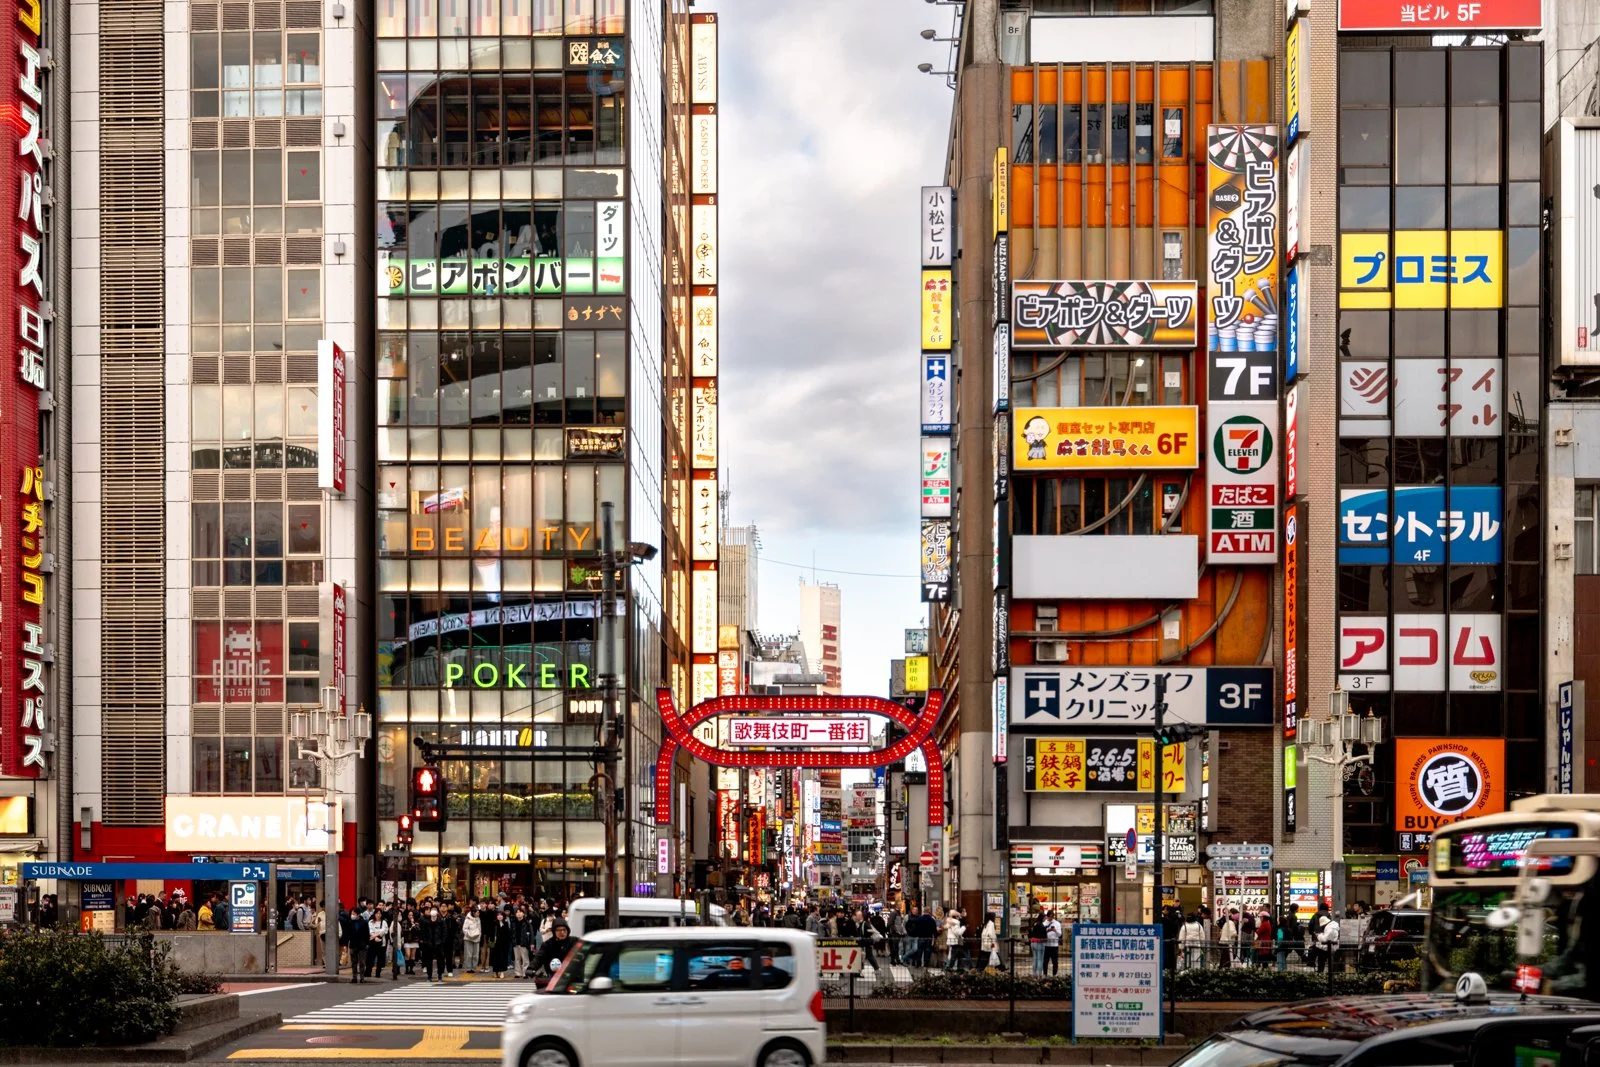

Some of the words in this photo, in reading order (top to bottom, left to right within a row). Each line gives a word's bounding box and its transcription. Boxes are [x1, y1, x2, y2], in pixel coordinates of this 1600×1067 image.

[705, 15, 714, 23] 10
[1400, 5, 1450, 21] 当ビル
[1457, 4, 1481, 22] 5F
[1008, 26, 1020, 35] 8F
[589, 48, 620, 64] 魚金
[708, 106, 715, 114] 9
[700, 119, 709, 157] CASINO
[700, 159, 709, 190] POKER
[928, 192, 945, 261] 小松ビル
[1244, 161, 1276, 274] ビアポン
[602, 204, 619, 250] ダーツ
[410, 260, 591, 292] ビアポンバー
[1353, 251, 1493, 285] プロミス
[708, 288, 715, 296] 7
[1016, 294, 1193, 329] ビアポン&ダーツ
[708, 380, 715, 388] 6
[1215, 357, 1273, 396] 7F
[1437, 367, 1496, 393] アイ
[1056, 438, 1153, 457] 麻雀龍馬くん
[1157, 432, 1189, 455] 6F
[709, 471, 716, 479] 5
[1217, 485, 1269, 505] たばこ
[1230, 509, 1255, 529] 酒
[1341, 510, 1500, 543] セントラル
[20, 464, 44, 606] パチンコ
[411, 527, 591, 551] BEAUTY
[1216, 534, 1272, 553] ATM
[1413, 550, 1431, 562] 4F
[708, 562, 715, 570] 4
[925, 584, 948, 599] 7F
[906, 630, 928, 641] ポケット
[911, 641, 924, 652] ビル
[1342, 626, 1496, 668] アコム
[709, 655, 715, 664] 3
[212, 658, 271, 686] GAME
[445, 662, 591, 689] POKER
[1065, 673, 1194, 693] メンズライフ
[1352, 676, 1375, 689] 3F
[23, 621, 46, 769] エスパス
[212, 688, 236, 697] TATO
[237, 688, 271, 697] STAION
[1219, 682, 1263, 709] 3F
[1065, 700, 1169, 720] クリニック
[734, 722, 865, 741] 歌舞伎町一番街
[1047, 742, 1076, 752] 名物
[1164, 745, 1184, 766] ール
[1427, 743, 1469, 756] PAWNSHOP
[1026, 756, 1035, 773] 2F
[1040, 754, 1082, 771] 鉄鍋
[1410, 754, 1427, 780] BRANDS
[1470, 751, 1491, 779] WATCHES
[1040, 771, 1081, 789] 餃子
[1098, 766, 1126, 782] 酒場
[1426, 760, 1474, 811] 質
[1410, 782, 1424, 810] LUXURY
[1477, 781, 1491, 810] JEWELRY
[172, 814, 283, 840] CRANE
[1404, 815, 1442, 829] BUY
[1169, 837, 1188, 845] BUZZ
[1401, 834, 1411, 850] 買取
[31, 865, 93, 877] SUBNADE
[242, 866, 251, 878] P
[83, 883, 113, 894] SUBNADE
[233, 887, 246, 905] P
[84, 916, 90, 930] 3
[1079, 927, 1156, 936] 道路切替のお知らせ
[1080, 938, 1155, 951] 新宿駅西口駅前広場
[1079, 952, 1156, 961] 自動車の通行ルートが変わります
